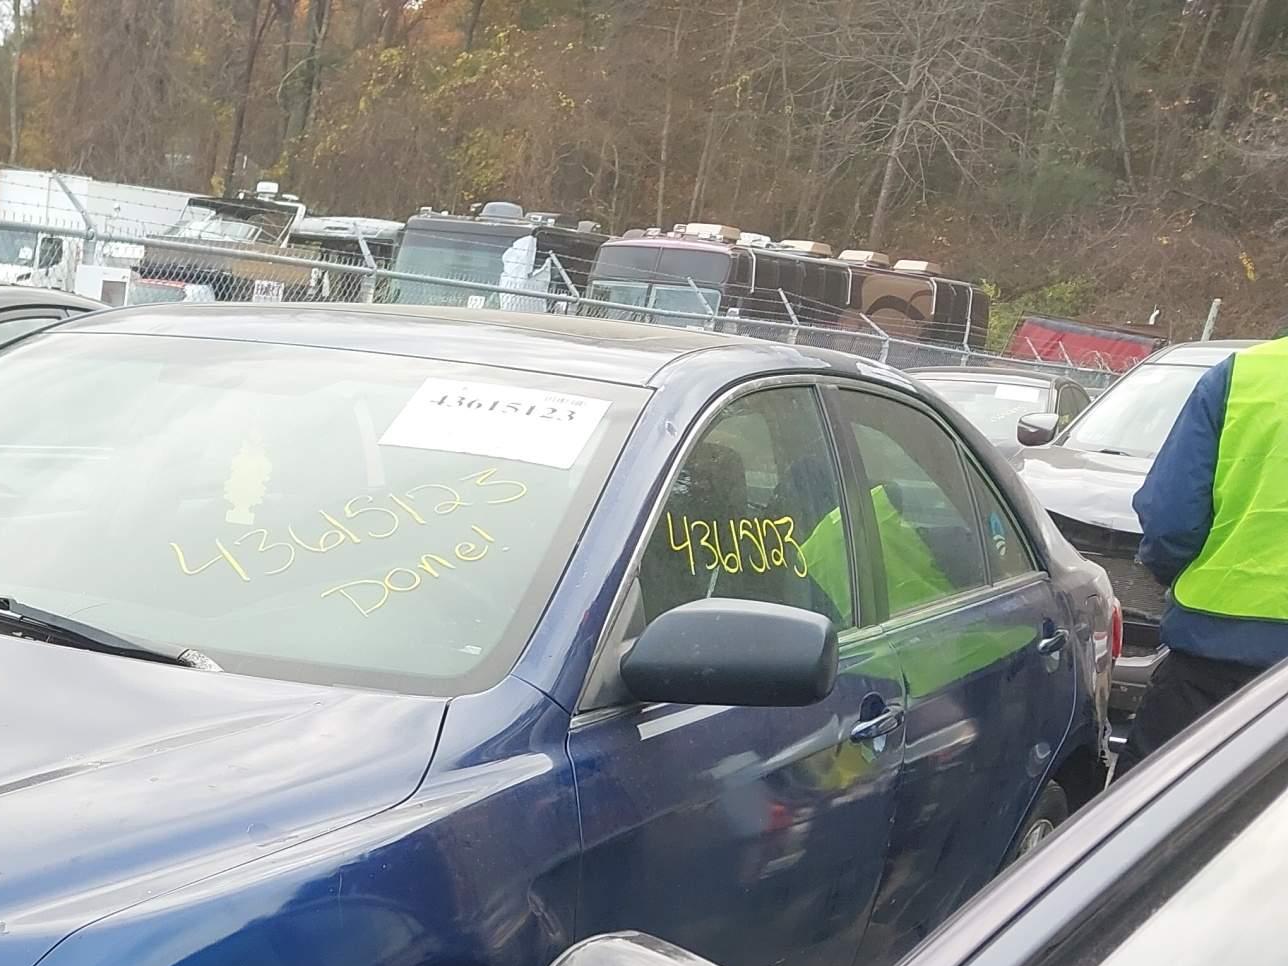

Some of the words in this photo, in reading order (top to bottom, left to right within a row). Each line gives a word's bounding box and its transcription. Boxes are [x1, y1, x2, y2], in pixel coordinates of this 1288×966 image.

[429, 394, 578, 421] 43615123
[169, 467, 528, 581] 43615123
[667, 511, 808, 578] 43615123
